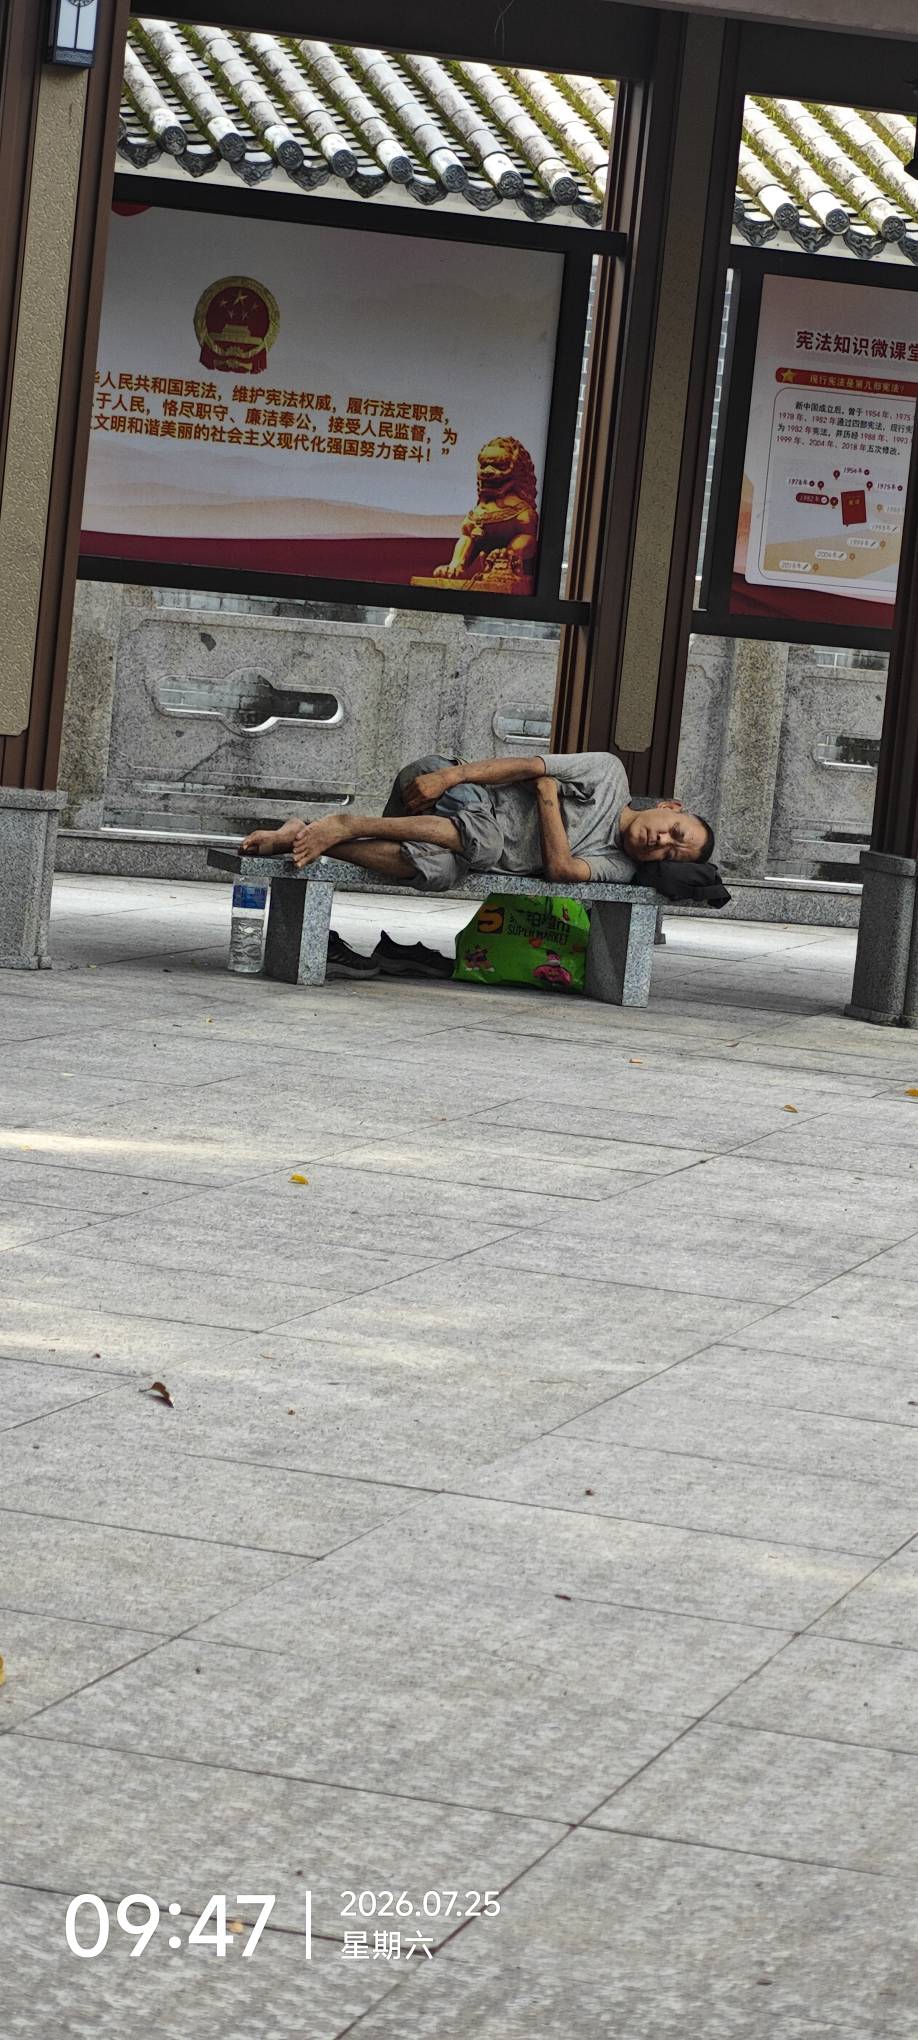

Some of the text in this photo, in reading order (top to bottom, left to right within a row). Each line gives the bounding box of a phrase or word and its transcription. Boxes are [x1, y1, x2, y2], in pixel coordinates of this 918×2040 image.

[796, 329, 918, 362] 宪法知识微课堂
[90, 414, 450, 464] 文明和谐美丽的社会主义现代化强国努力奋斗！”
[91, 392, 457, 445] 于人民，恪尽职守、廉洁奉公，接受人民监督，为
